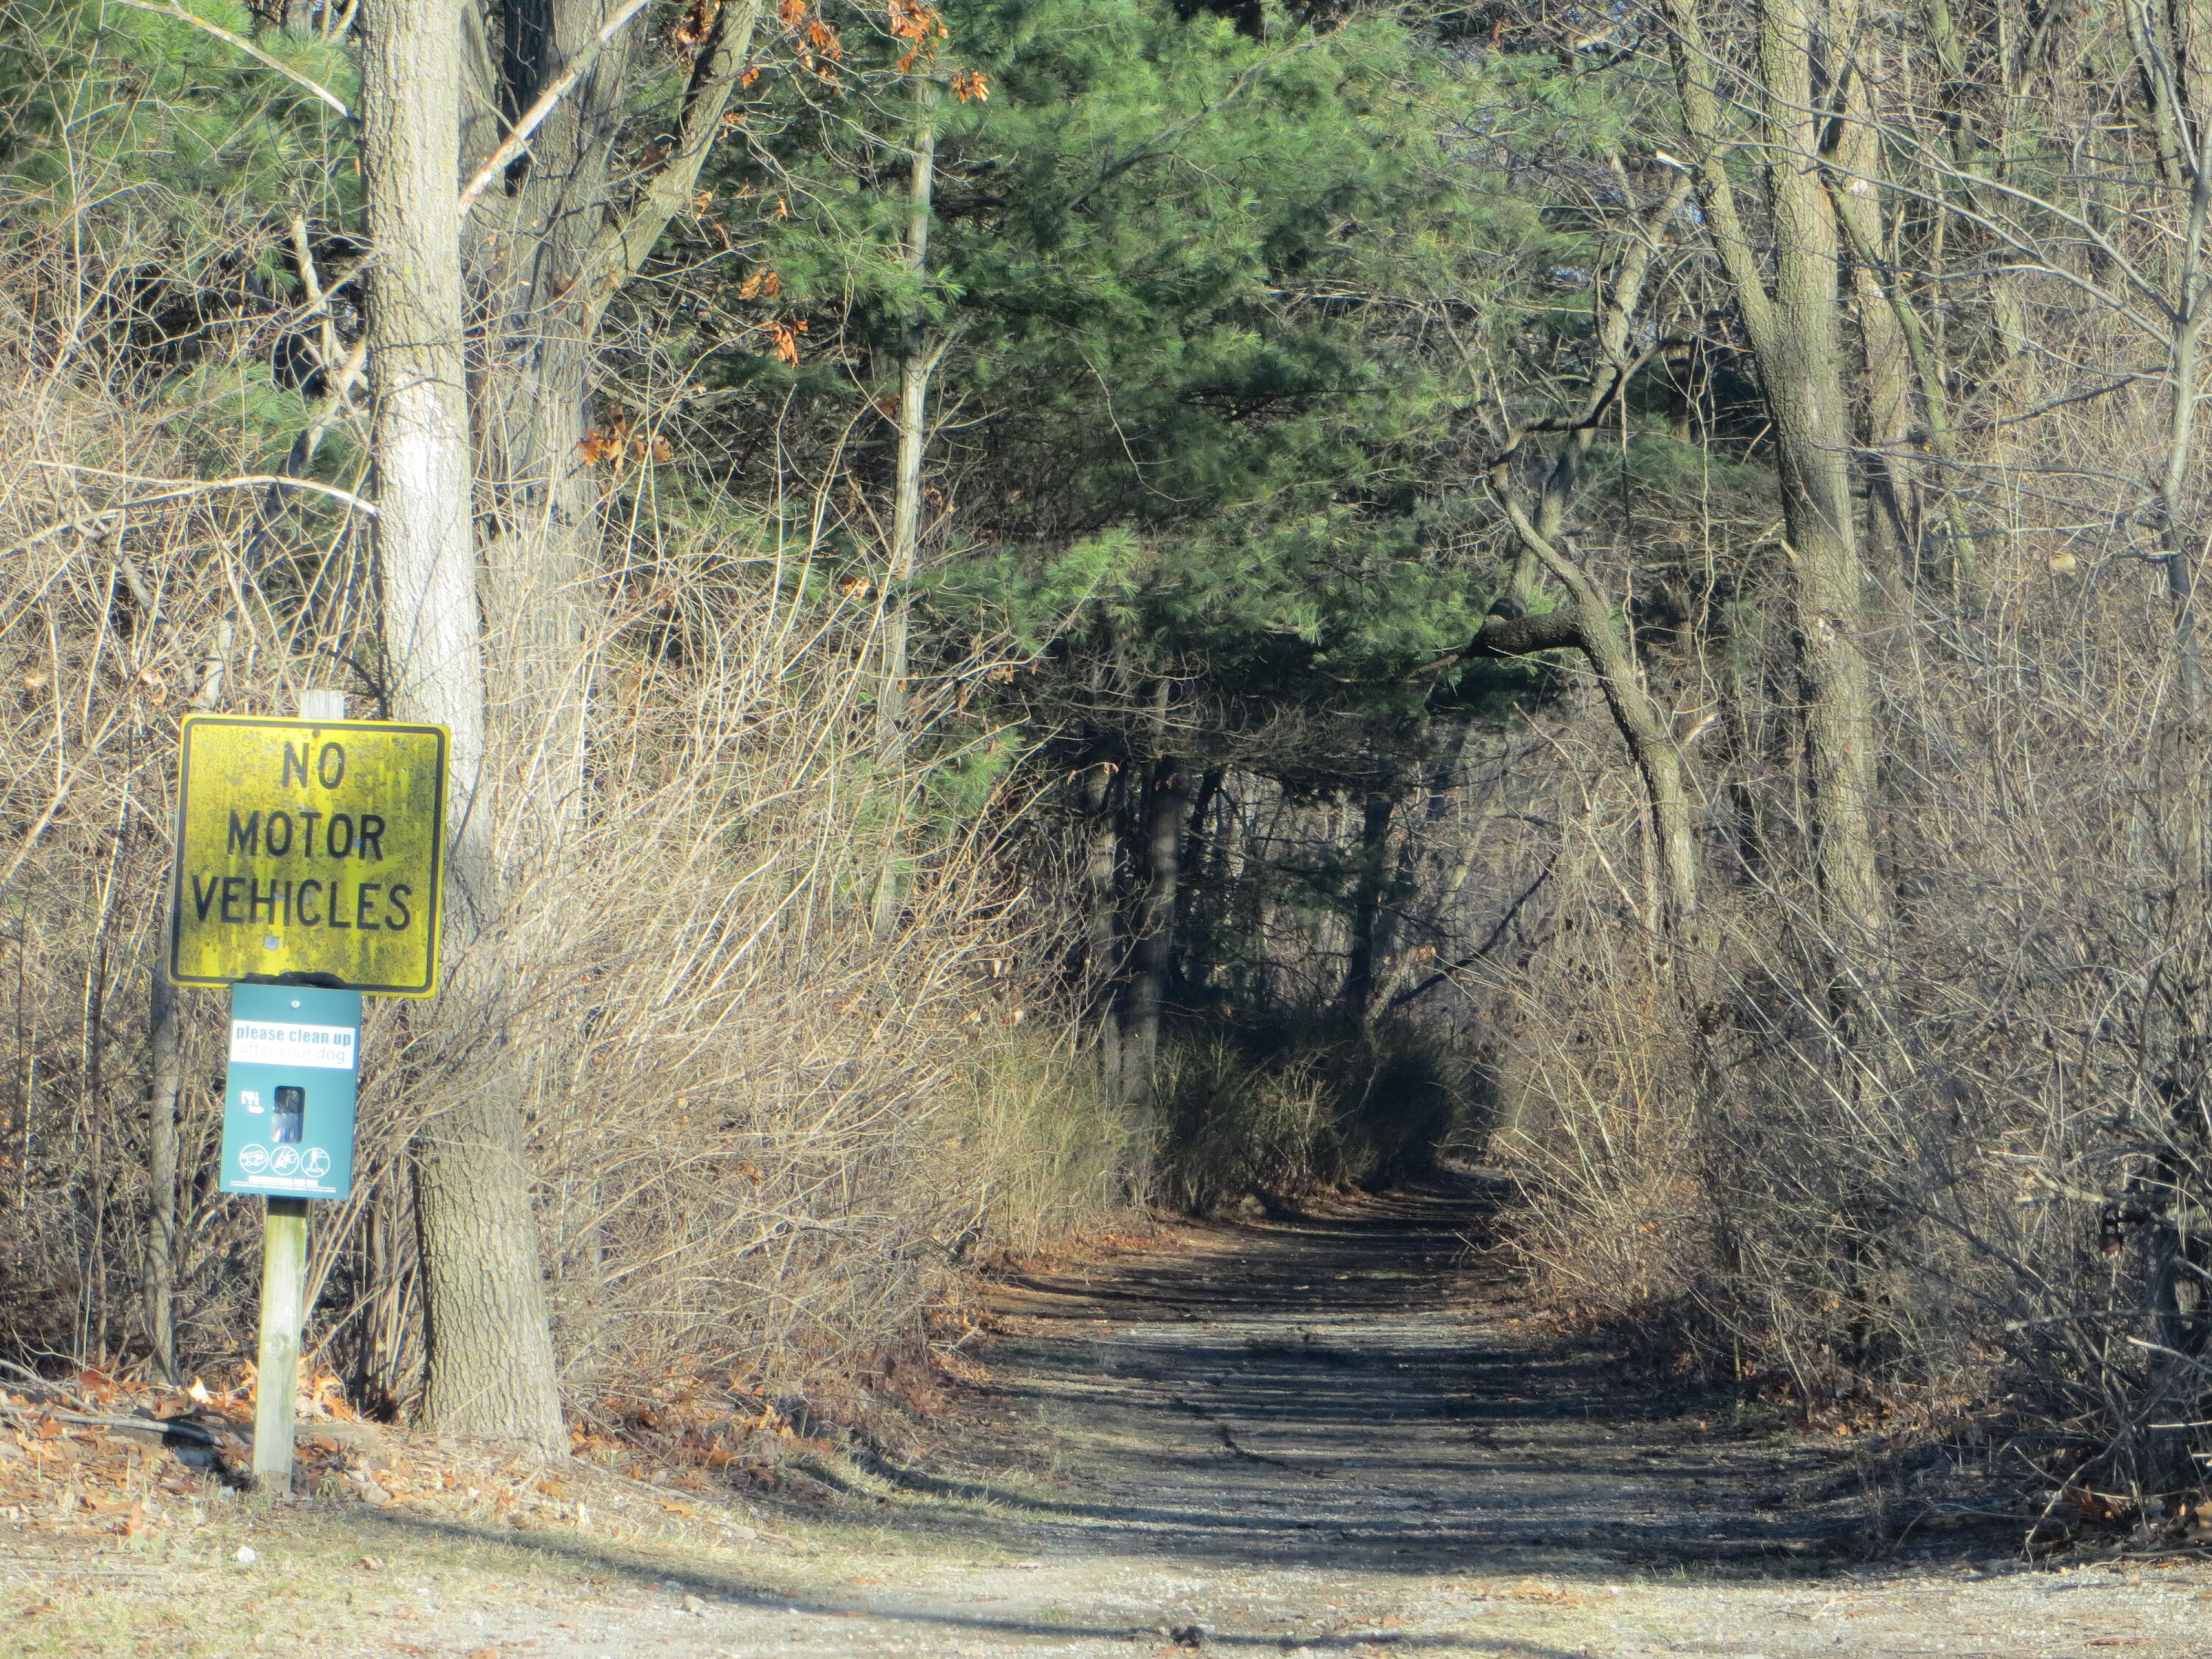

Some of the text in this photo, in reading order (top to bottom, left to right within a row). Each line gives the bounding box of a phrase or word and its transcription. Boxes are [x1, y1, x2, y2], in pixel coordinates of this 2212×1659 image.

[282, 741, 346, 790] NO
[227, 809, 386, 861] MOTOR
[192, 874, 413, 931] VEHICLES
[236, 1025, 352, 1047] please clean up
[240, 1041, 346, 1064] after your dog
